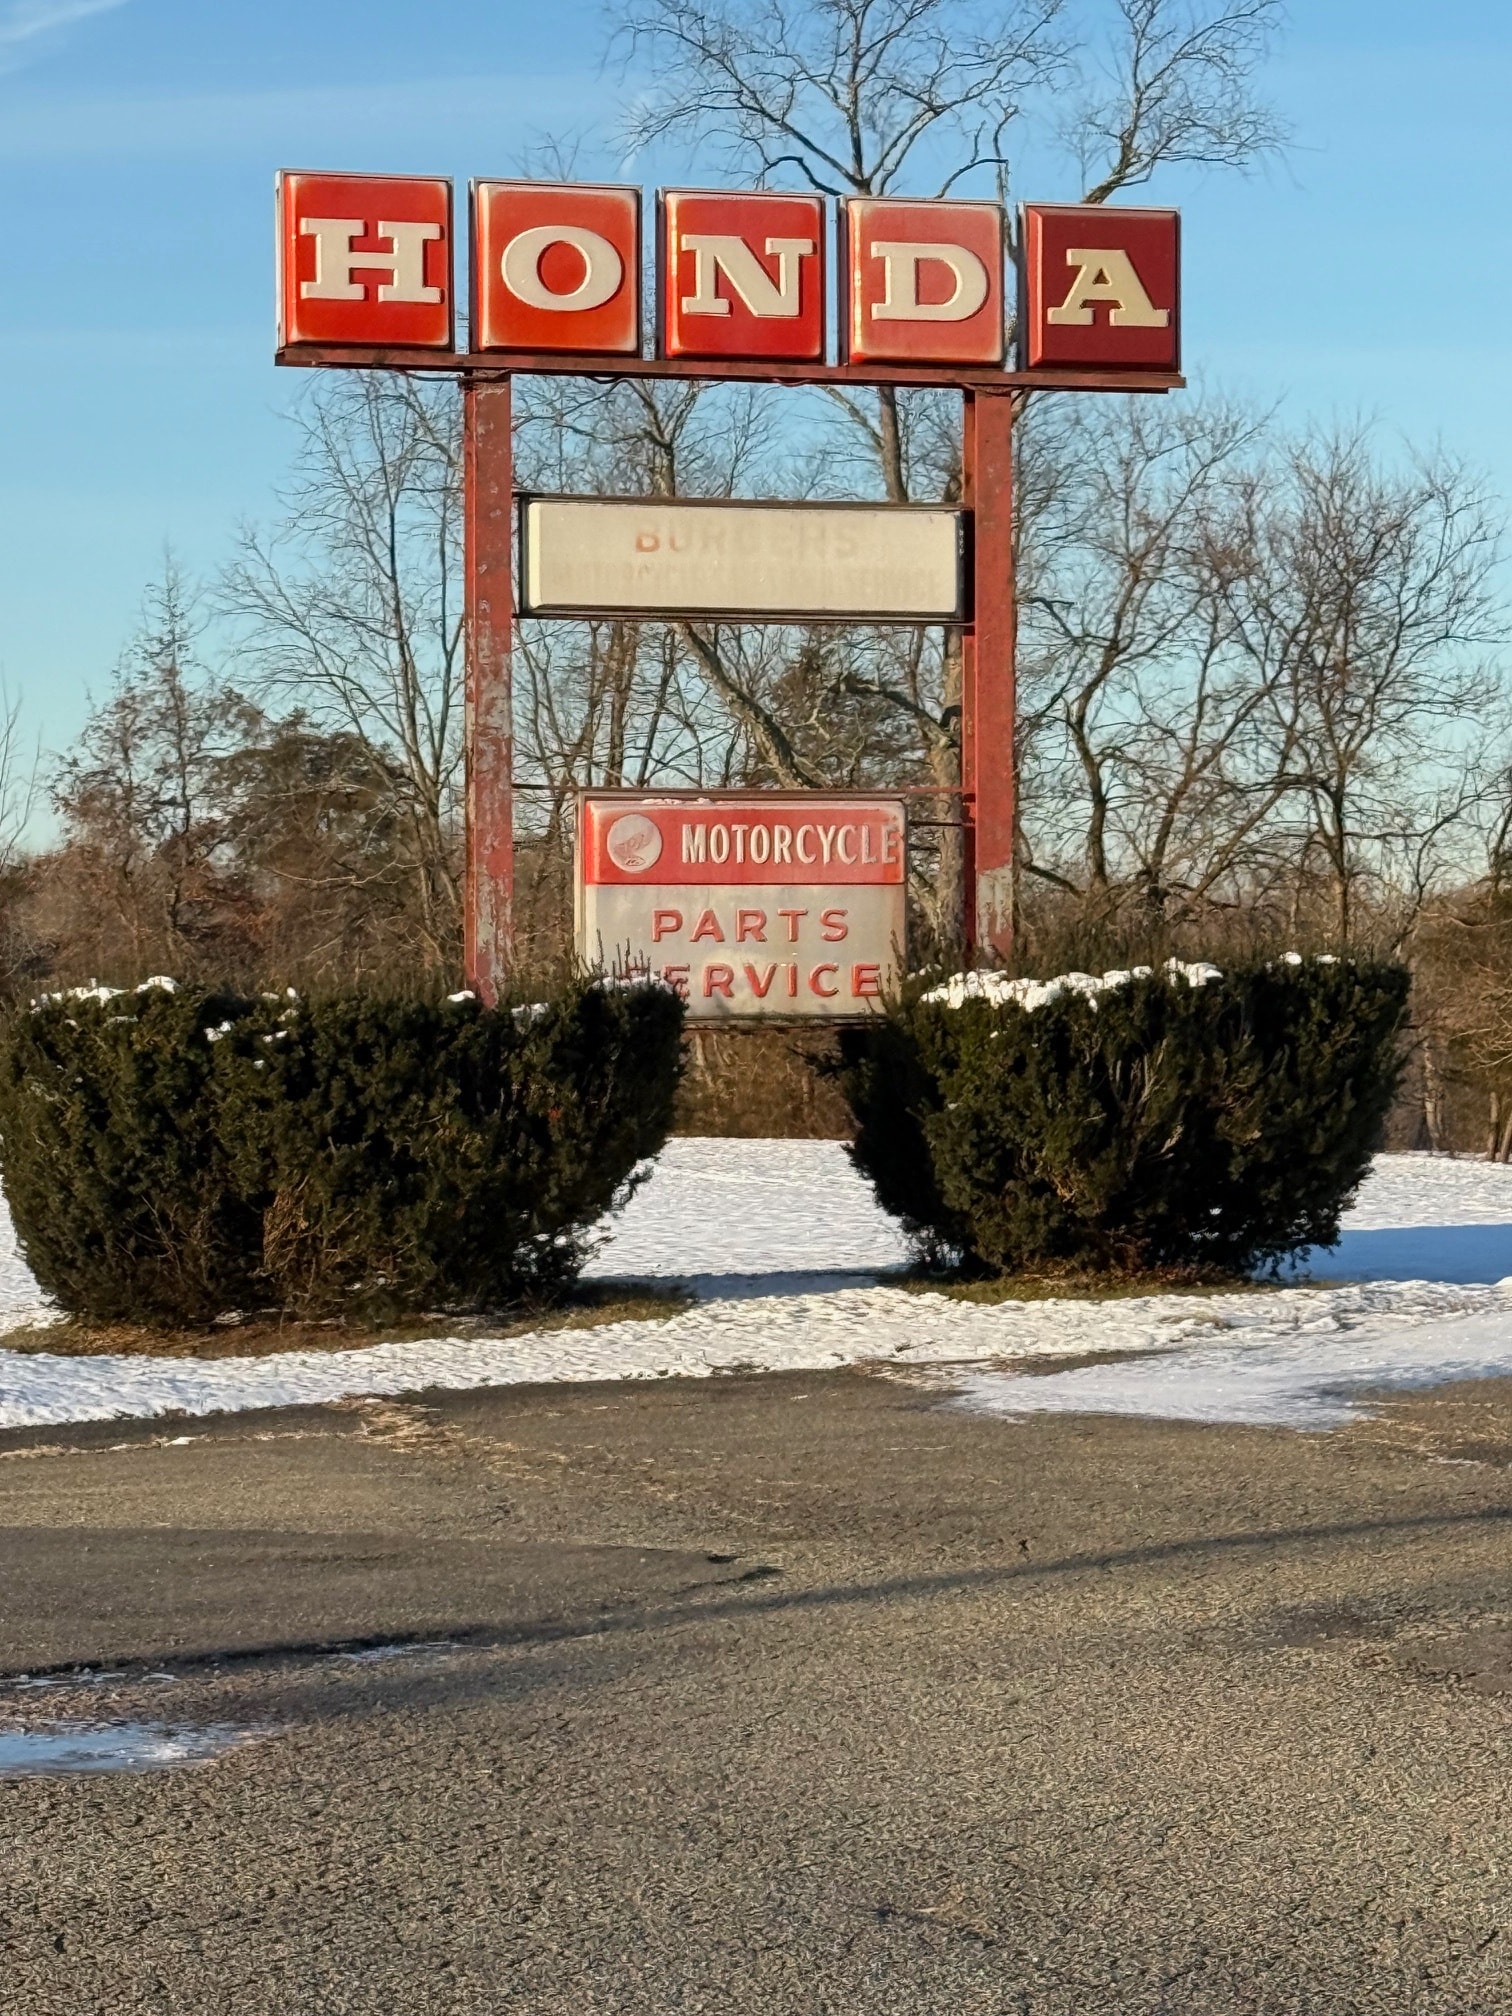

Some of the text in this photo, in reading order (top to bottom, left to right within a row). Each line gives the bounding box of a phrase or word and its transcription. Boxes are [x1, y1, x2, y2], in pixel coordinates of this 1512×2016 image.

[300, 216, 1170, 328] HONDA
[681, 823, 897, 865] MOTORCYCLE
[652, 909, 849, 942] PARTS
[624, 962, 881, 997] ERVICE
